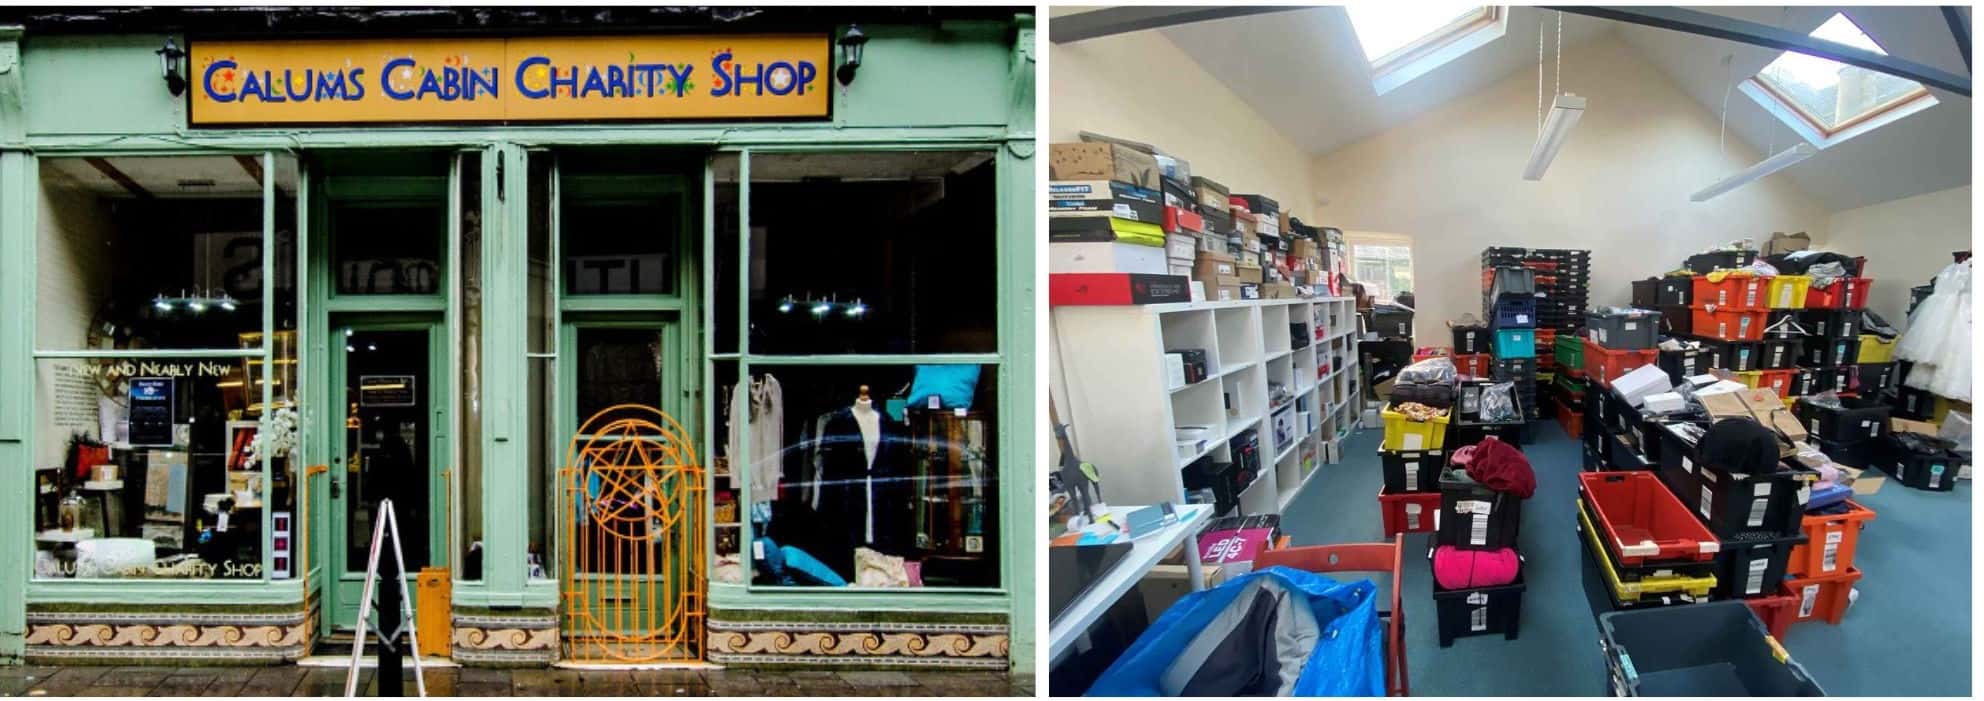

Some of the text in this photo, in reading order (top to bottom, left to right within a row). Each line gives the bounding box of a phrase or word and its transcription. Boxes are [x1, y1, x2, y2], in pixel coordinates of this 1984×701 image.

[203, 53, 817, 102] CALUMS CABIN CHARITY SHOP
[72, 361, 231, 377] NEW AND NEARLY NEW
[223, 560, 262, 576] SHOP
